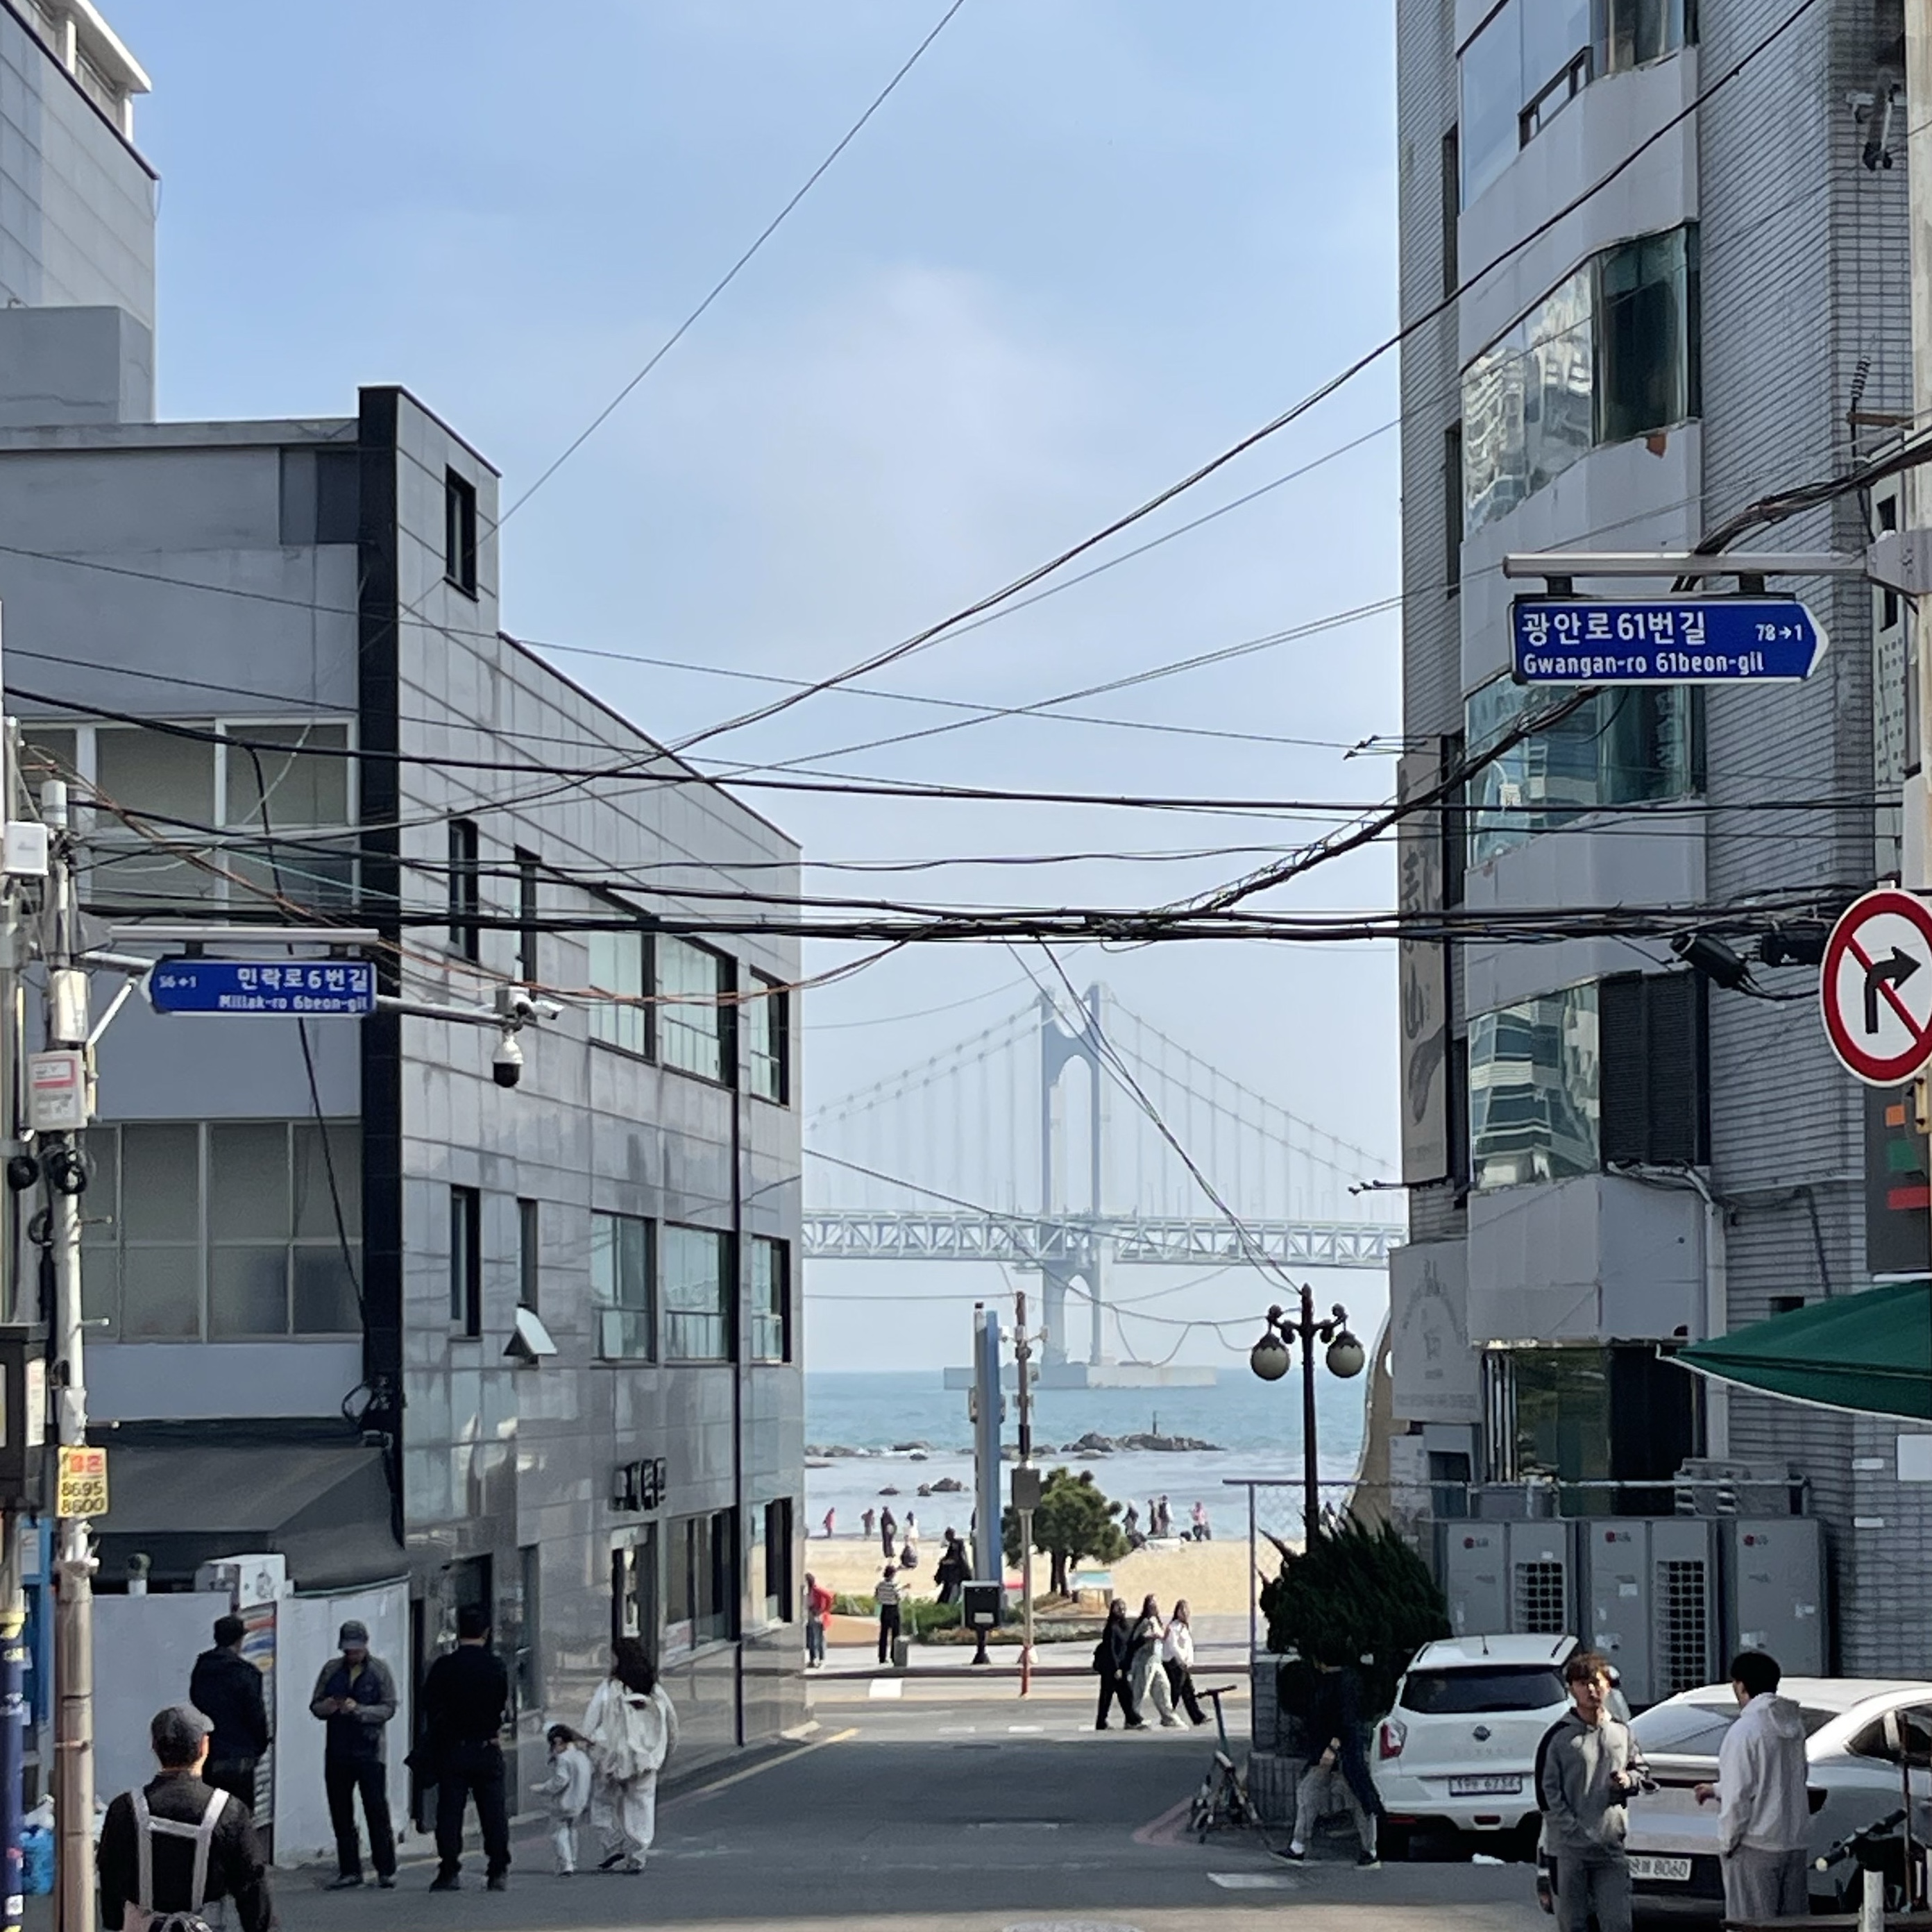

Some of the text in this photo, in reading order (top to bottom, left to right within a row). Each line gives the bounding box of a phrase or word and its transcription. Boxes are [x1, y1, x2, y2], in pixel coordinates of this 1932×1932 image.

[1521, 611, 1706, 647] 광안로61번길
[1523, 651, 1764, 678] Gwangan-ro 61beon-gil
[237, 967, 368, 992] 민락로6번길
[219, 995, 368, 1012] Millak-ro 6beon-gil
